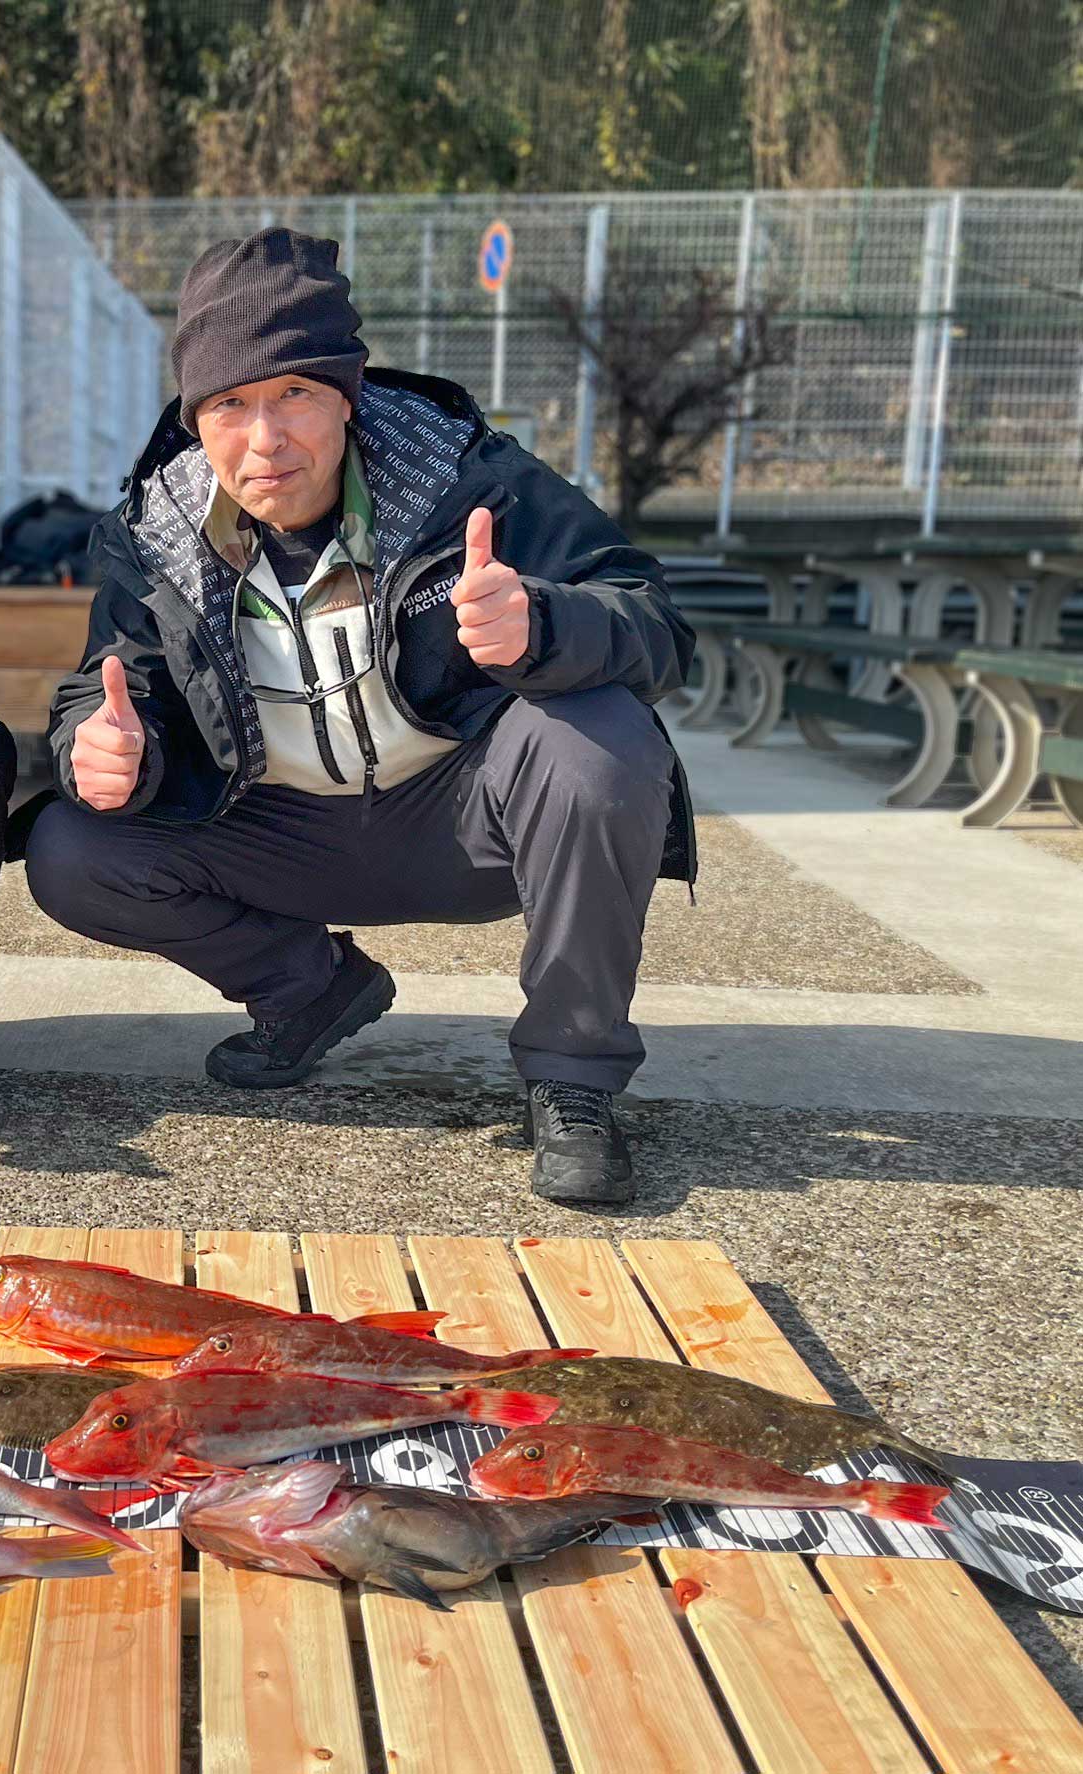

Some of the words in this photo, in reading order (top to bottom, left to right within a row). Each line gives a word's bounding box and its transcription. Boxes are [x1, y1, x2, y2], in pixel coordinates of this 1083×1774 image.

[360, 430, 382, 452] FIVE
[373, 418, 399, 438] HIGH
[399, 438, 423, 456] FIVE
[413, 422, 439, 442] HIGH
[384, 451, 411, 474] HIGH
[411, 469, 437, 489] FIVE
[425, 454, 454, 474] HIGH
[372, 466, 397, 489] FIVE
[399, 486, 426, 508] HIGH
[385, 503, 412, 524] FIVE
[160, 520, 186, 541] FIVE
[171, 532, 196, 557] HIGH
[402, 588, 432, 609] HIGH
[433, 573, 460, 594] FIVE
[407, 588, 452, 618] FACTOR
